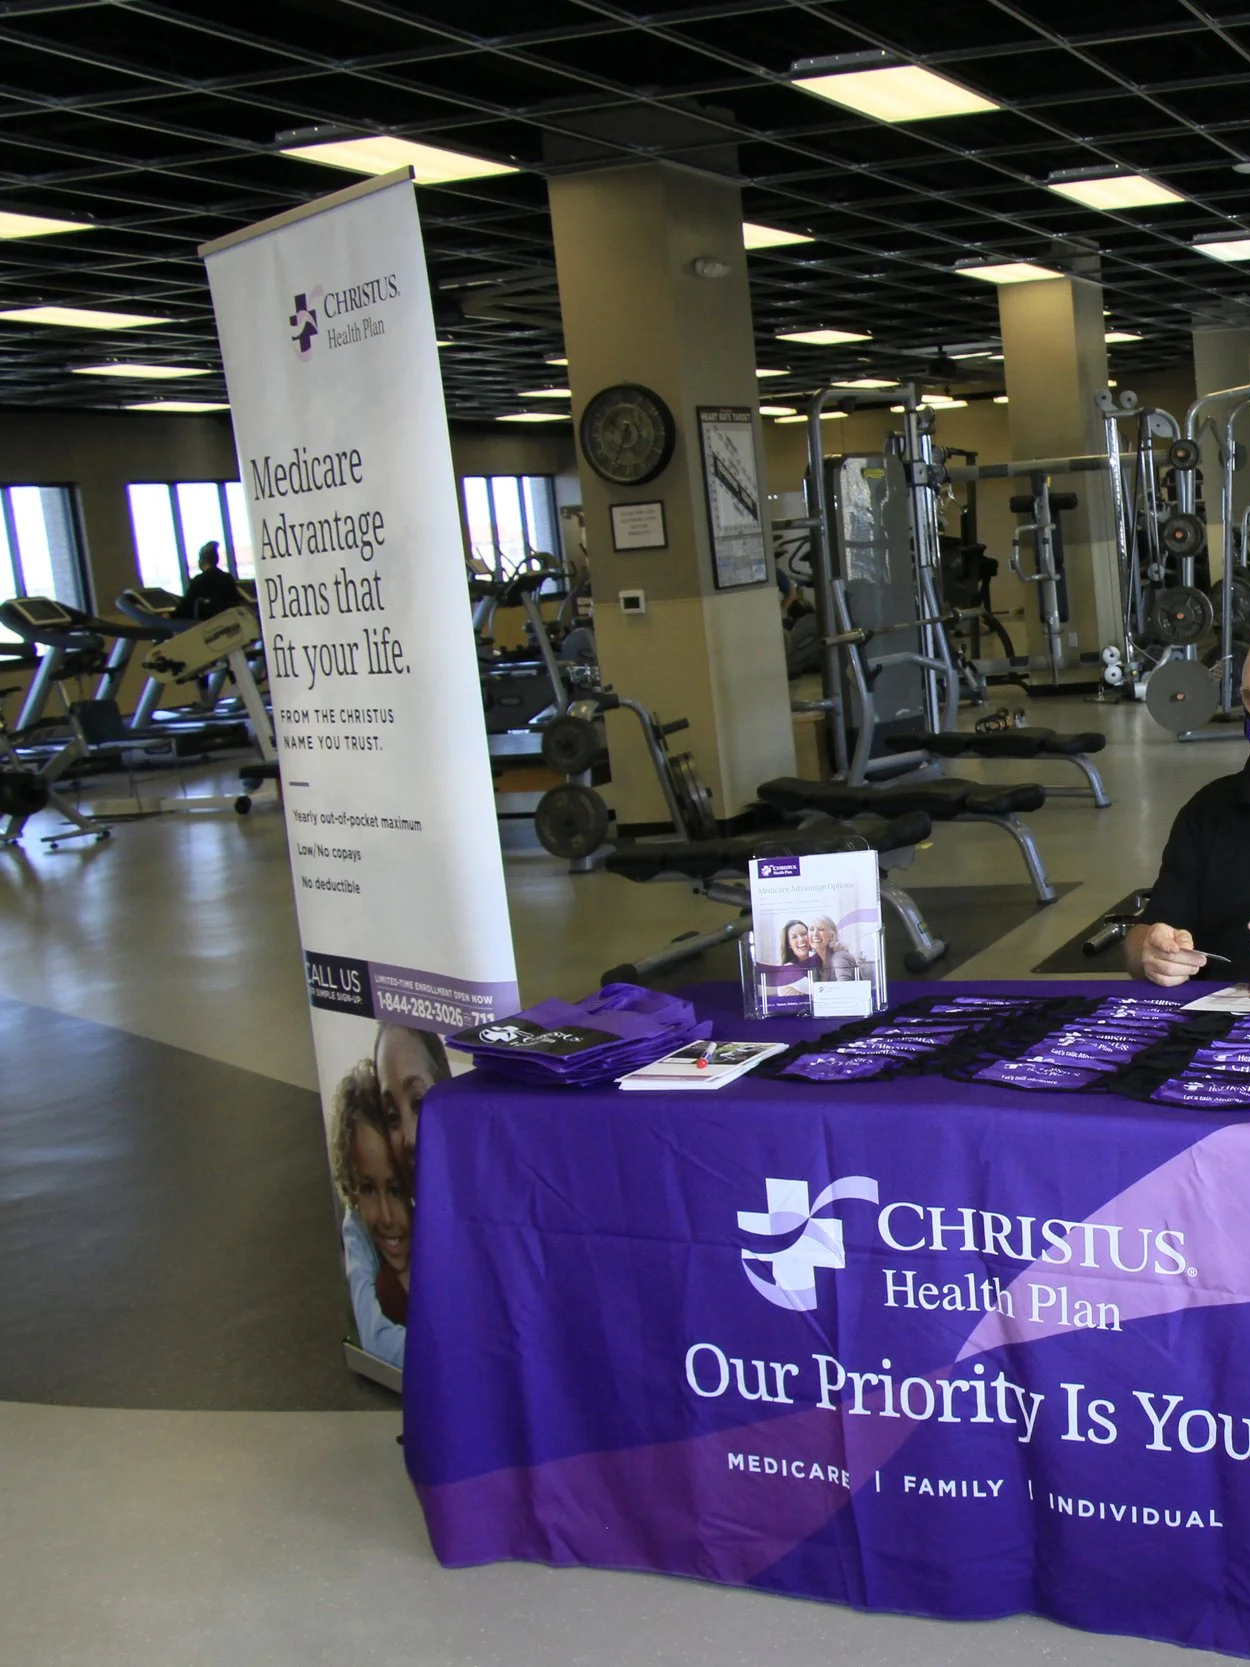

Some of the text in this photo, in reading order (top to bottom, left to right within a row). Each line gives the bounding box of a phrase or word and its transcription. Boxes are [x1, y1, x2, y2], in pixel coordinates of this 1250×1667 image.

[328, 317, 385, 349] Health Plan
[250, 448, 363, 501] Medicare
[261, 509, 385, 561] Advantage
[265, 569, 384, 619] Plans that
[273, 627, 410, 690] fit your life.
[280, 708, 395, 725] FROM THE CHRISTUS
[284, 735, 383, 751] NAME YOU TRUST.
[293, 809, 422, 832] Yearly out-of-pocket maximum
[297, 842, 362, 863] Low/No copays
[302, 875, 361, 895] No deductible
[340, 968, 361, 992] US
[414, 982, 453, 997] ENROLLMENT
[453, 990, 470, 1002] OPEN
[471, 994, 494, 1005] NOW
[882, 1269, 1123, 1332] Health Plan
[685, 1343, 799, 1404] Our
[812, 1353, 1045, 1443] Priority
[1060, 1382, 1118, 1445] Is
[727, 1452, 1224, 1528] MEDICARE FAMILY INDIVIDUAL
